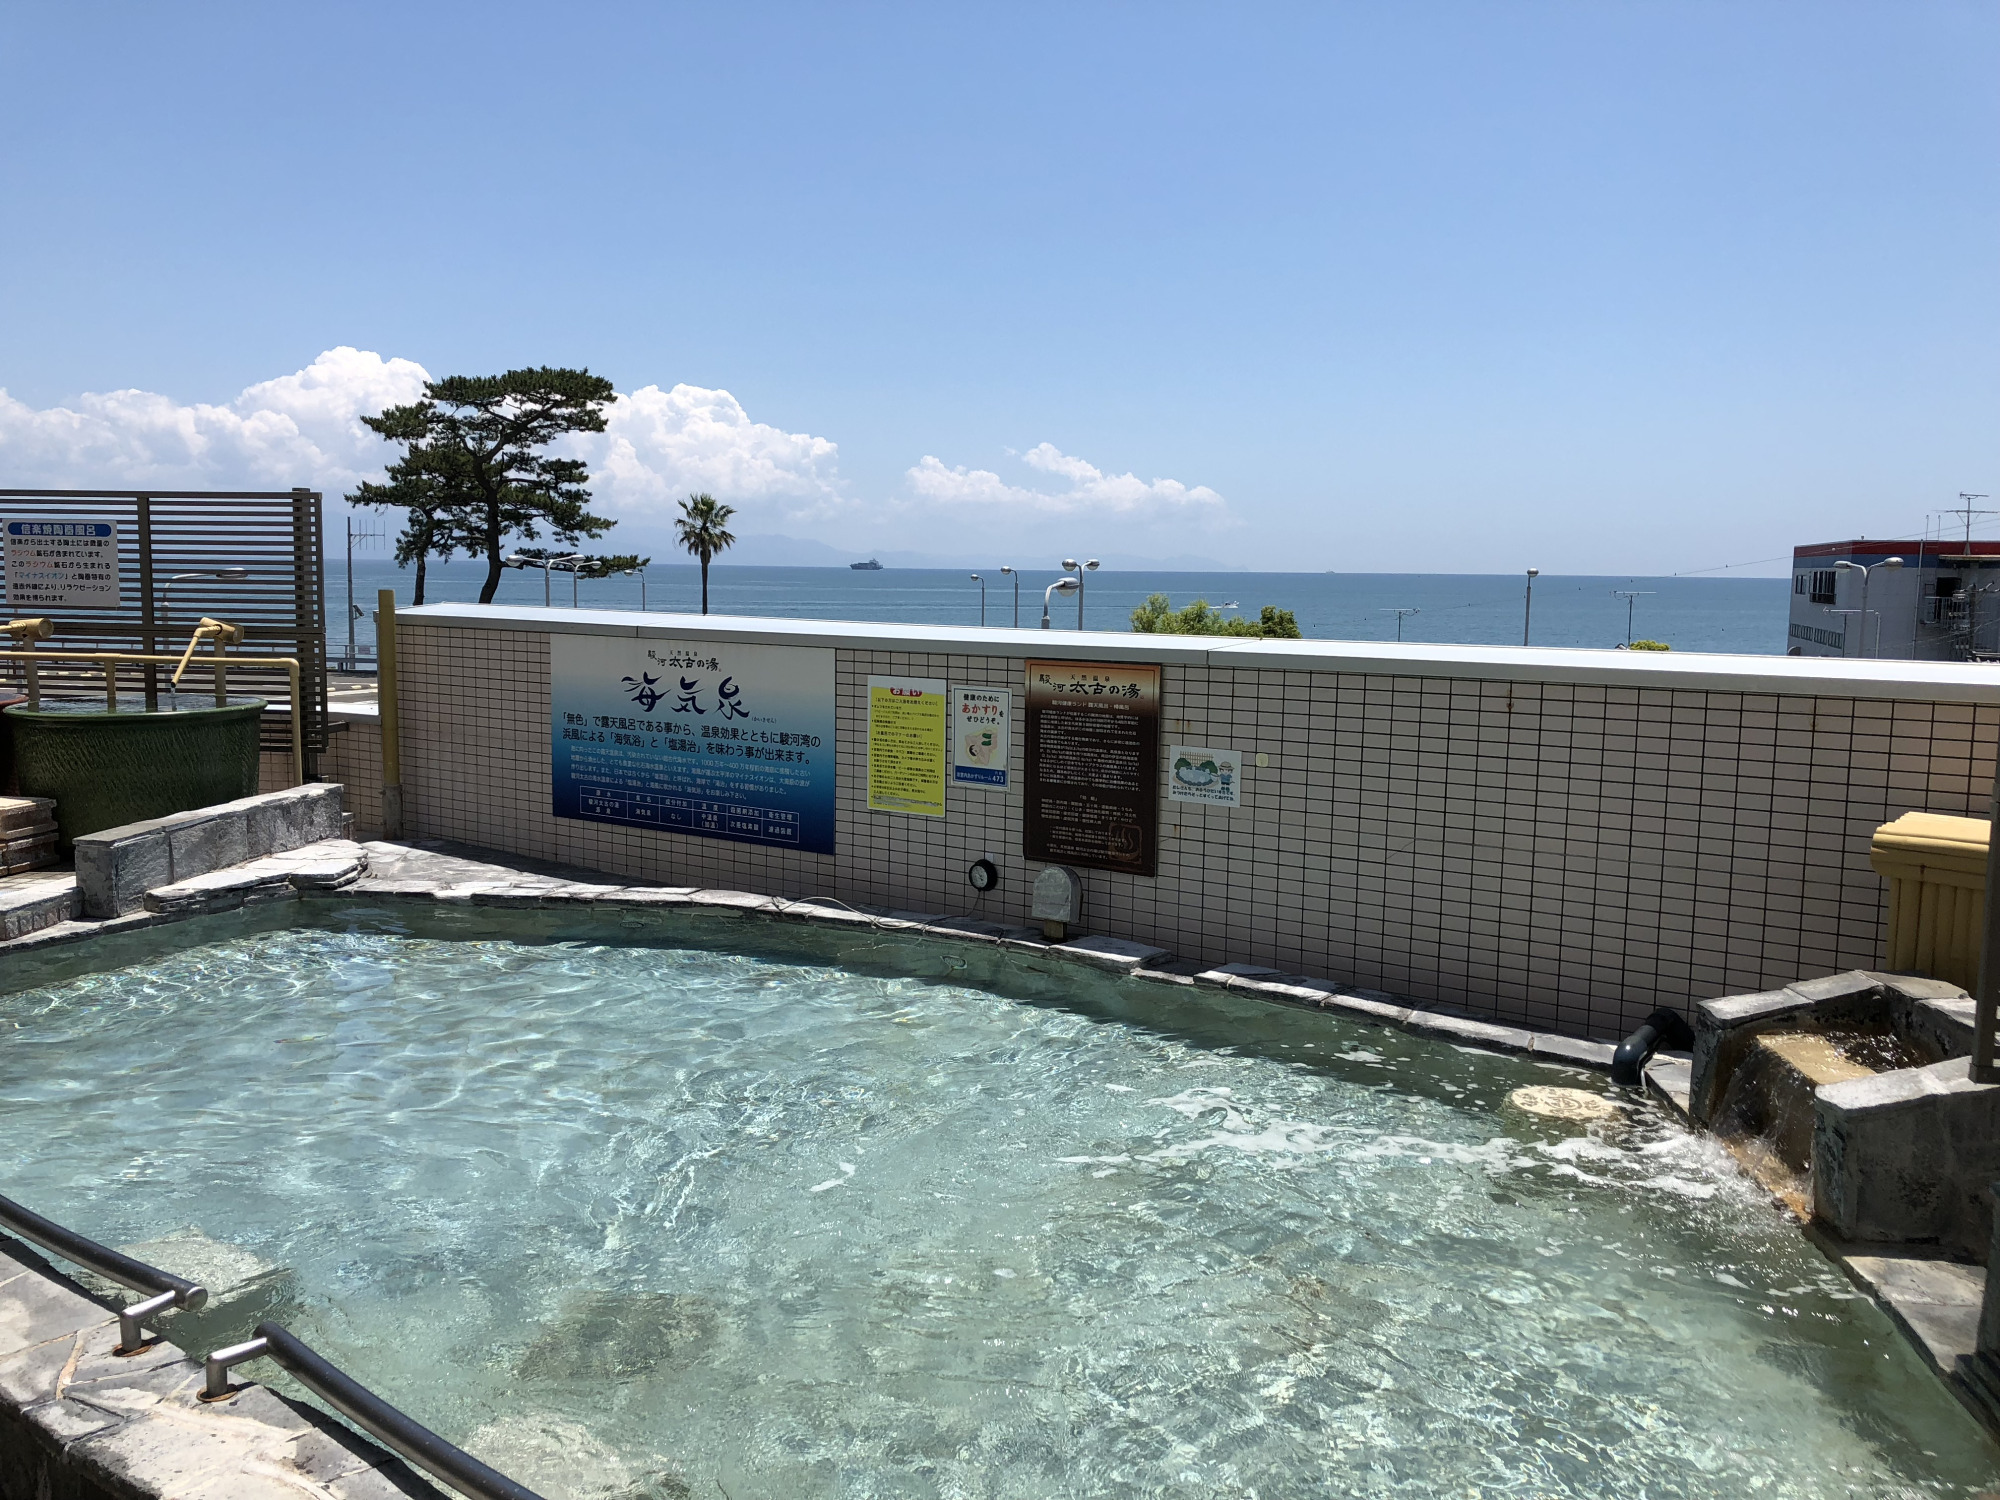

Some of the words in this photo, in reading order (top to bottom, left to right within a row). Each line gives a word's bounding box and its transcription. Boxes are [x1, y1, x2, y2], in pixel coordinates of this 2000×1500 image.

[1038, 673, 1141, 699] 駿河太古の湯
[992, 775, 1004, 783] 473
